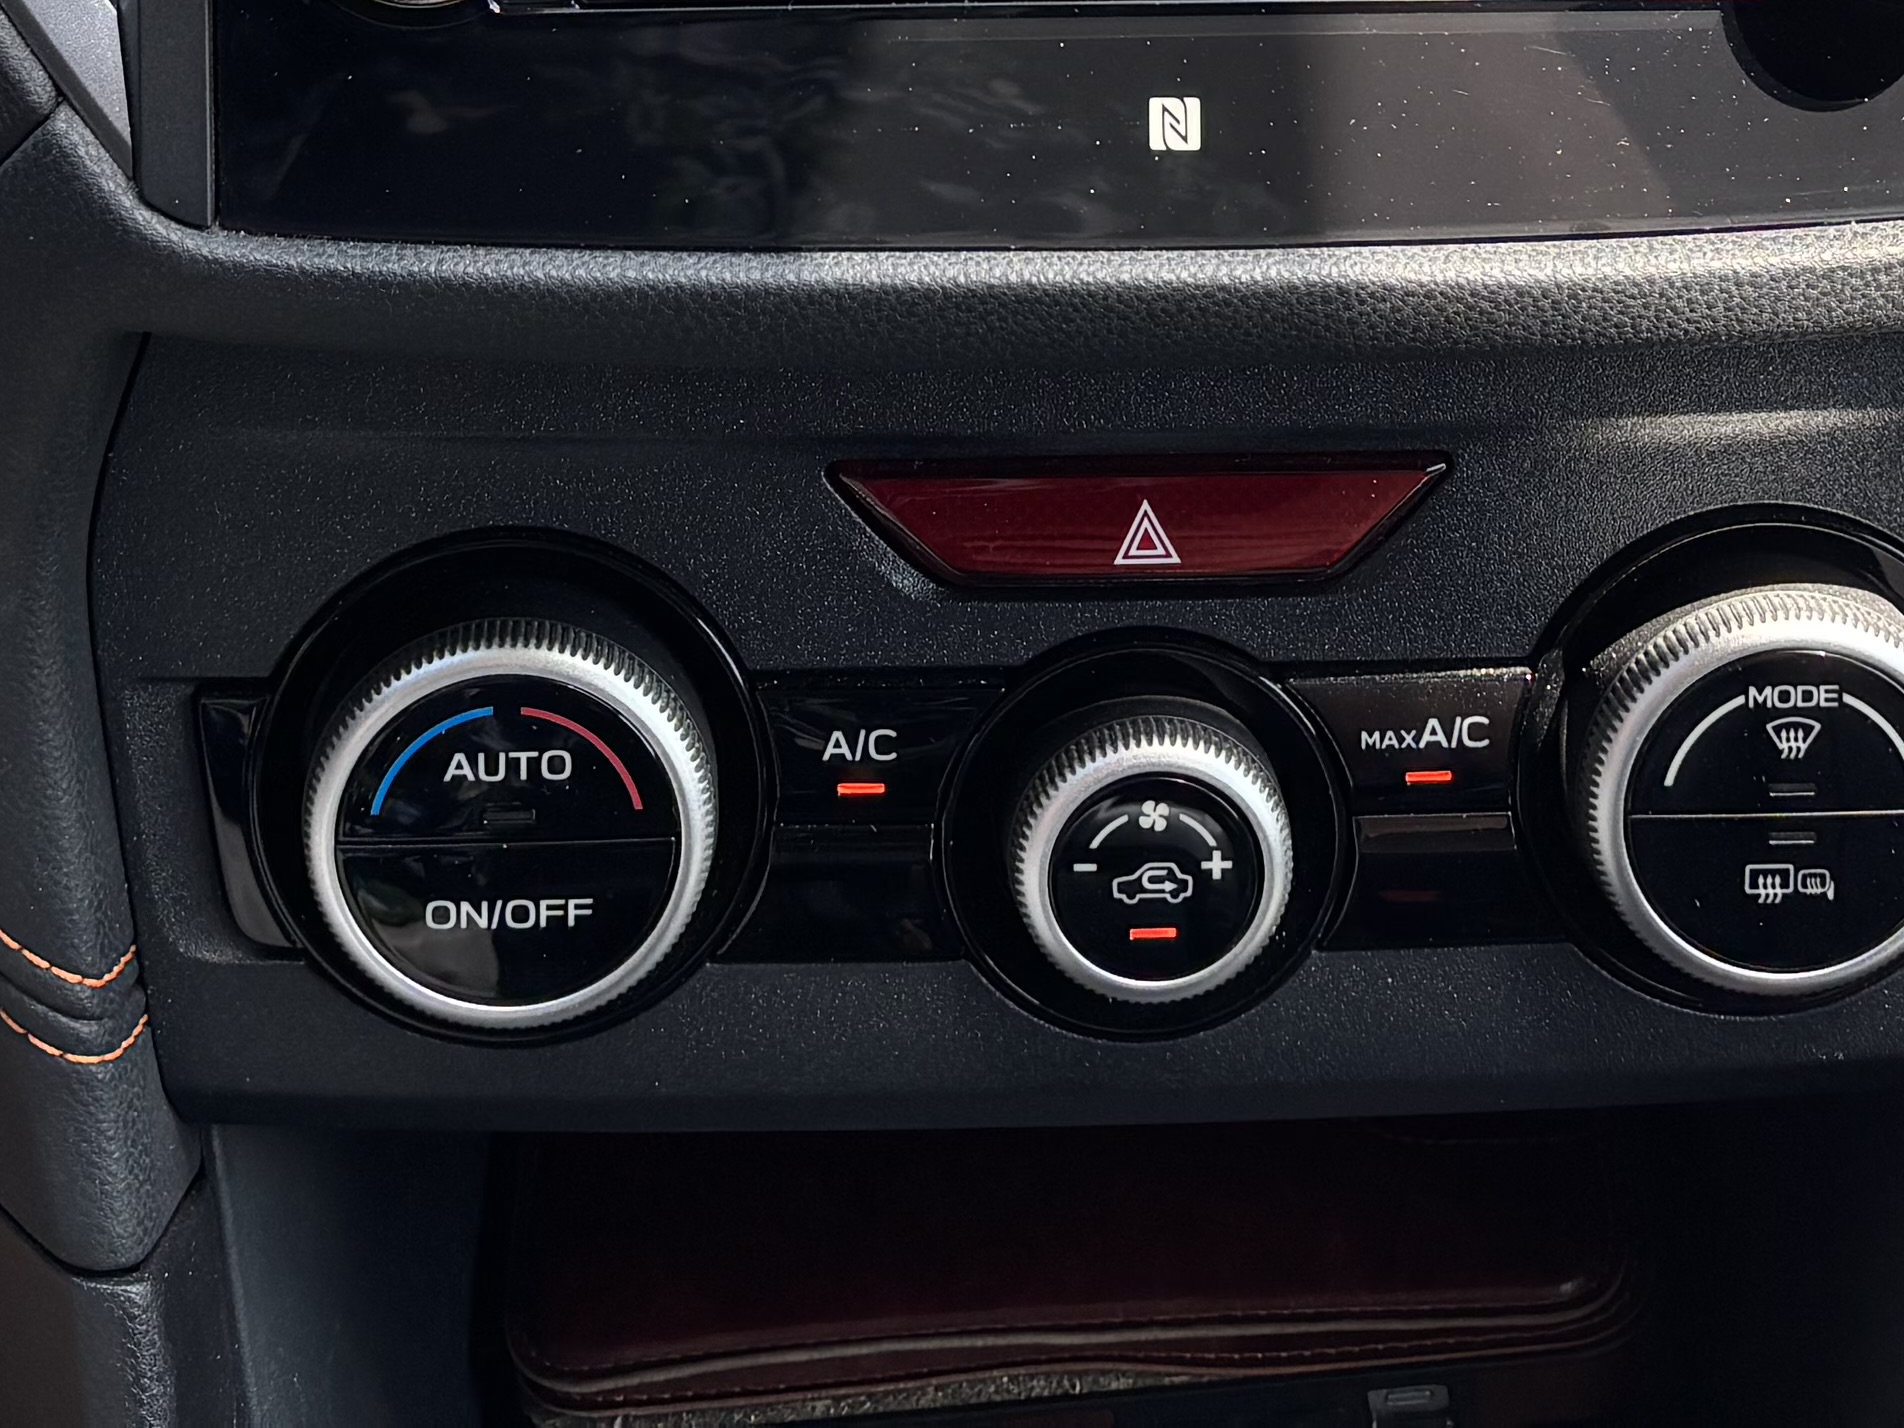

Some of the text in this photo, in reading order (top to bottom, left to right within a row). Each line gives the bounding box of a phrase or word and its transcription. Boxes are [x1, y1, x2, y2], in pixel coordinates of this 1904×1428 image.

[1749, 685, 1839, 708] MODE
[823, 729, 897, 761] A/C
[444, 750, 572, 782] AUTO
[426, 899, 593, 930] ON/OFF
